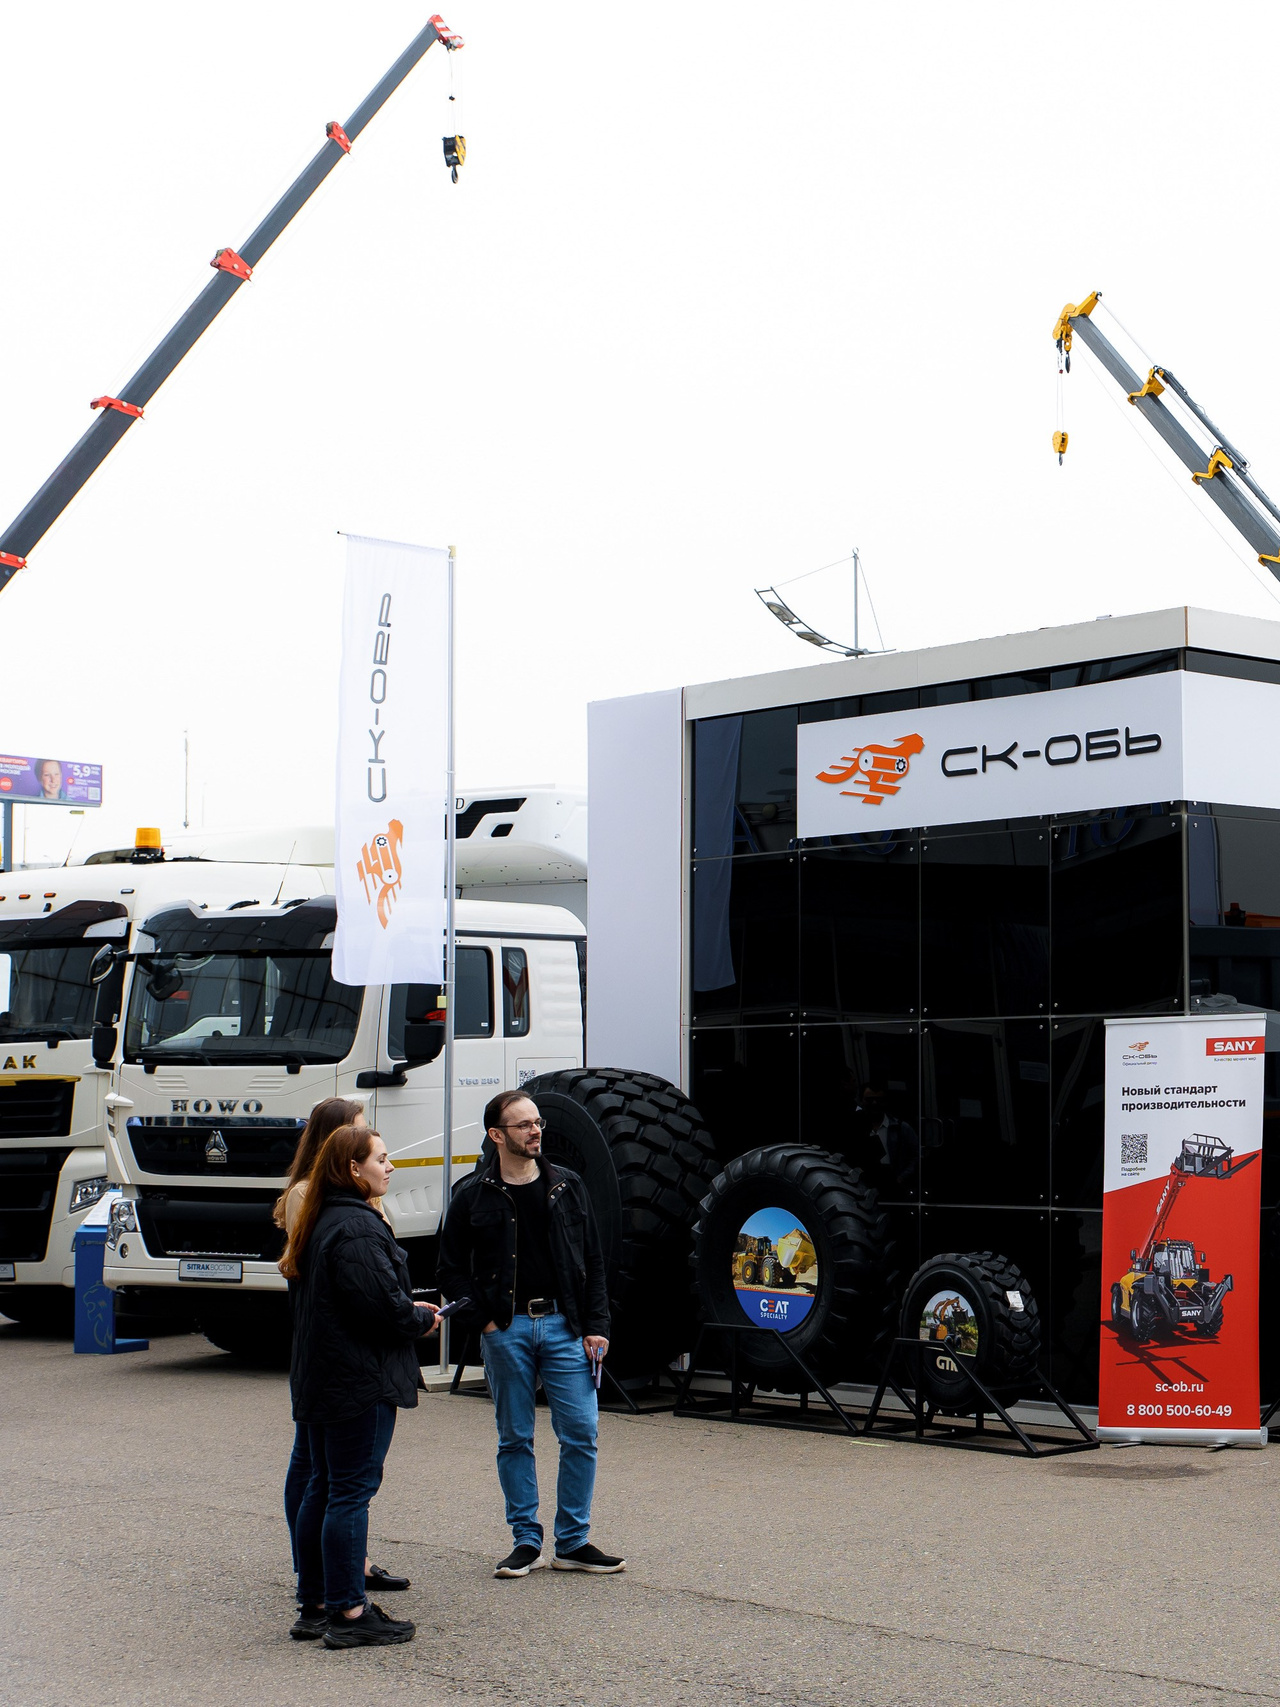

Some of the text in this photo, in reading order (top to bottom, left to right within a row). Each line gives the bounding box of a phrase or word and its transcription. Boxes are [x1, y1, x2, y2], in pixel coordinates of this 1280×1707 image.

[367, 592, 392, 803] СК-ОБЬ
[941, 725, 1163, 779] СК-ОБЬ
[73, 764, 91, 778] 5,9
[1214, 1040, 1257, 1052] SANY
[2, 1054, 38, 1070] AK
[1121, 1085, 1218, 1097] Новый стандарт
[171, 1099, 263, 1115] HOWO
[1121, 1099, 1246, 1112] производительности
[1156, 1179, 1170, 1215] SANY
[187, 1263, 210, 1271] SITRAK
[760, 1298, 789, 1314] CEAT
[760, 1312, 788, 1320] SPECIALTY
[1181, 1309, 1202, 1317] SANY
[1155, 1381, 1204, 1392] sc-ob.ru
[1126, 1404, 1232, 1417] 8 800 500-60-49
